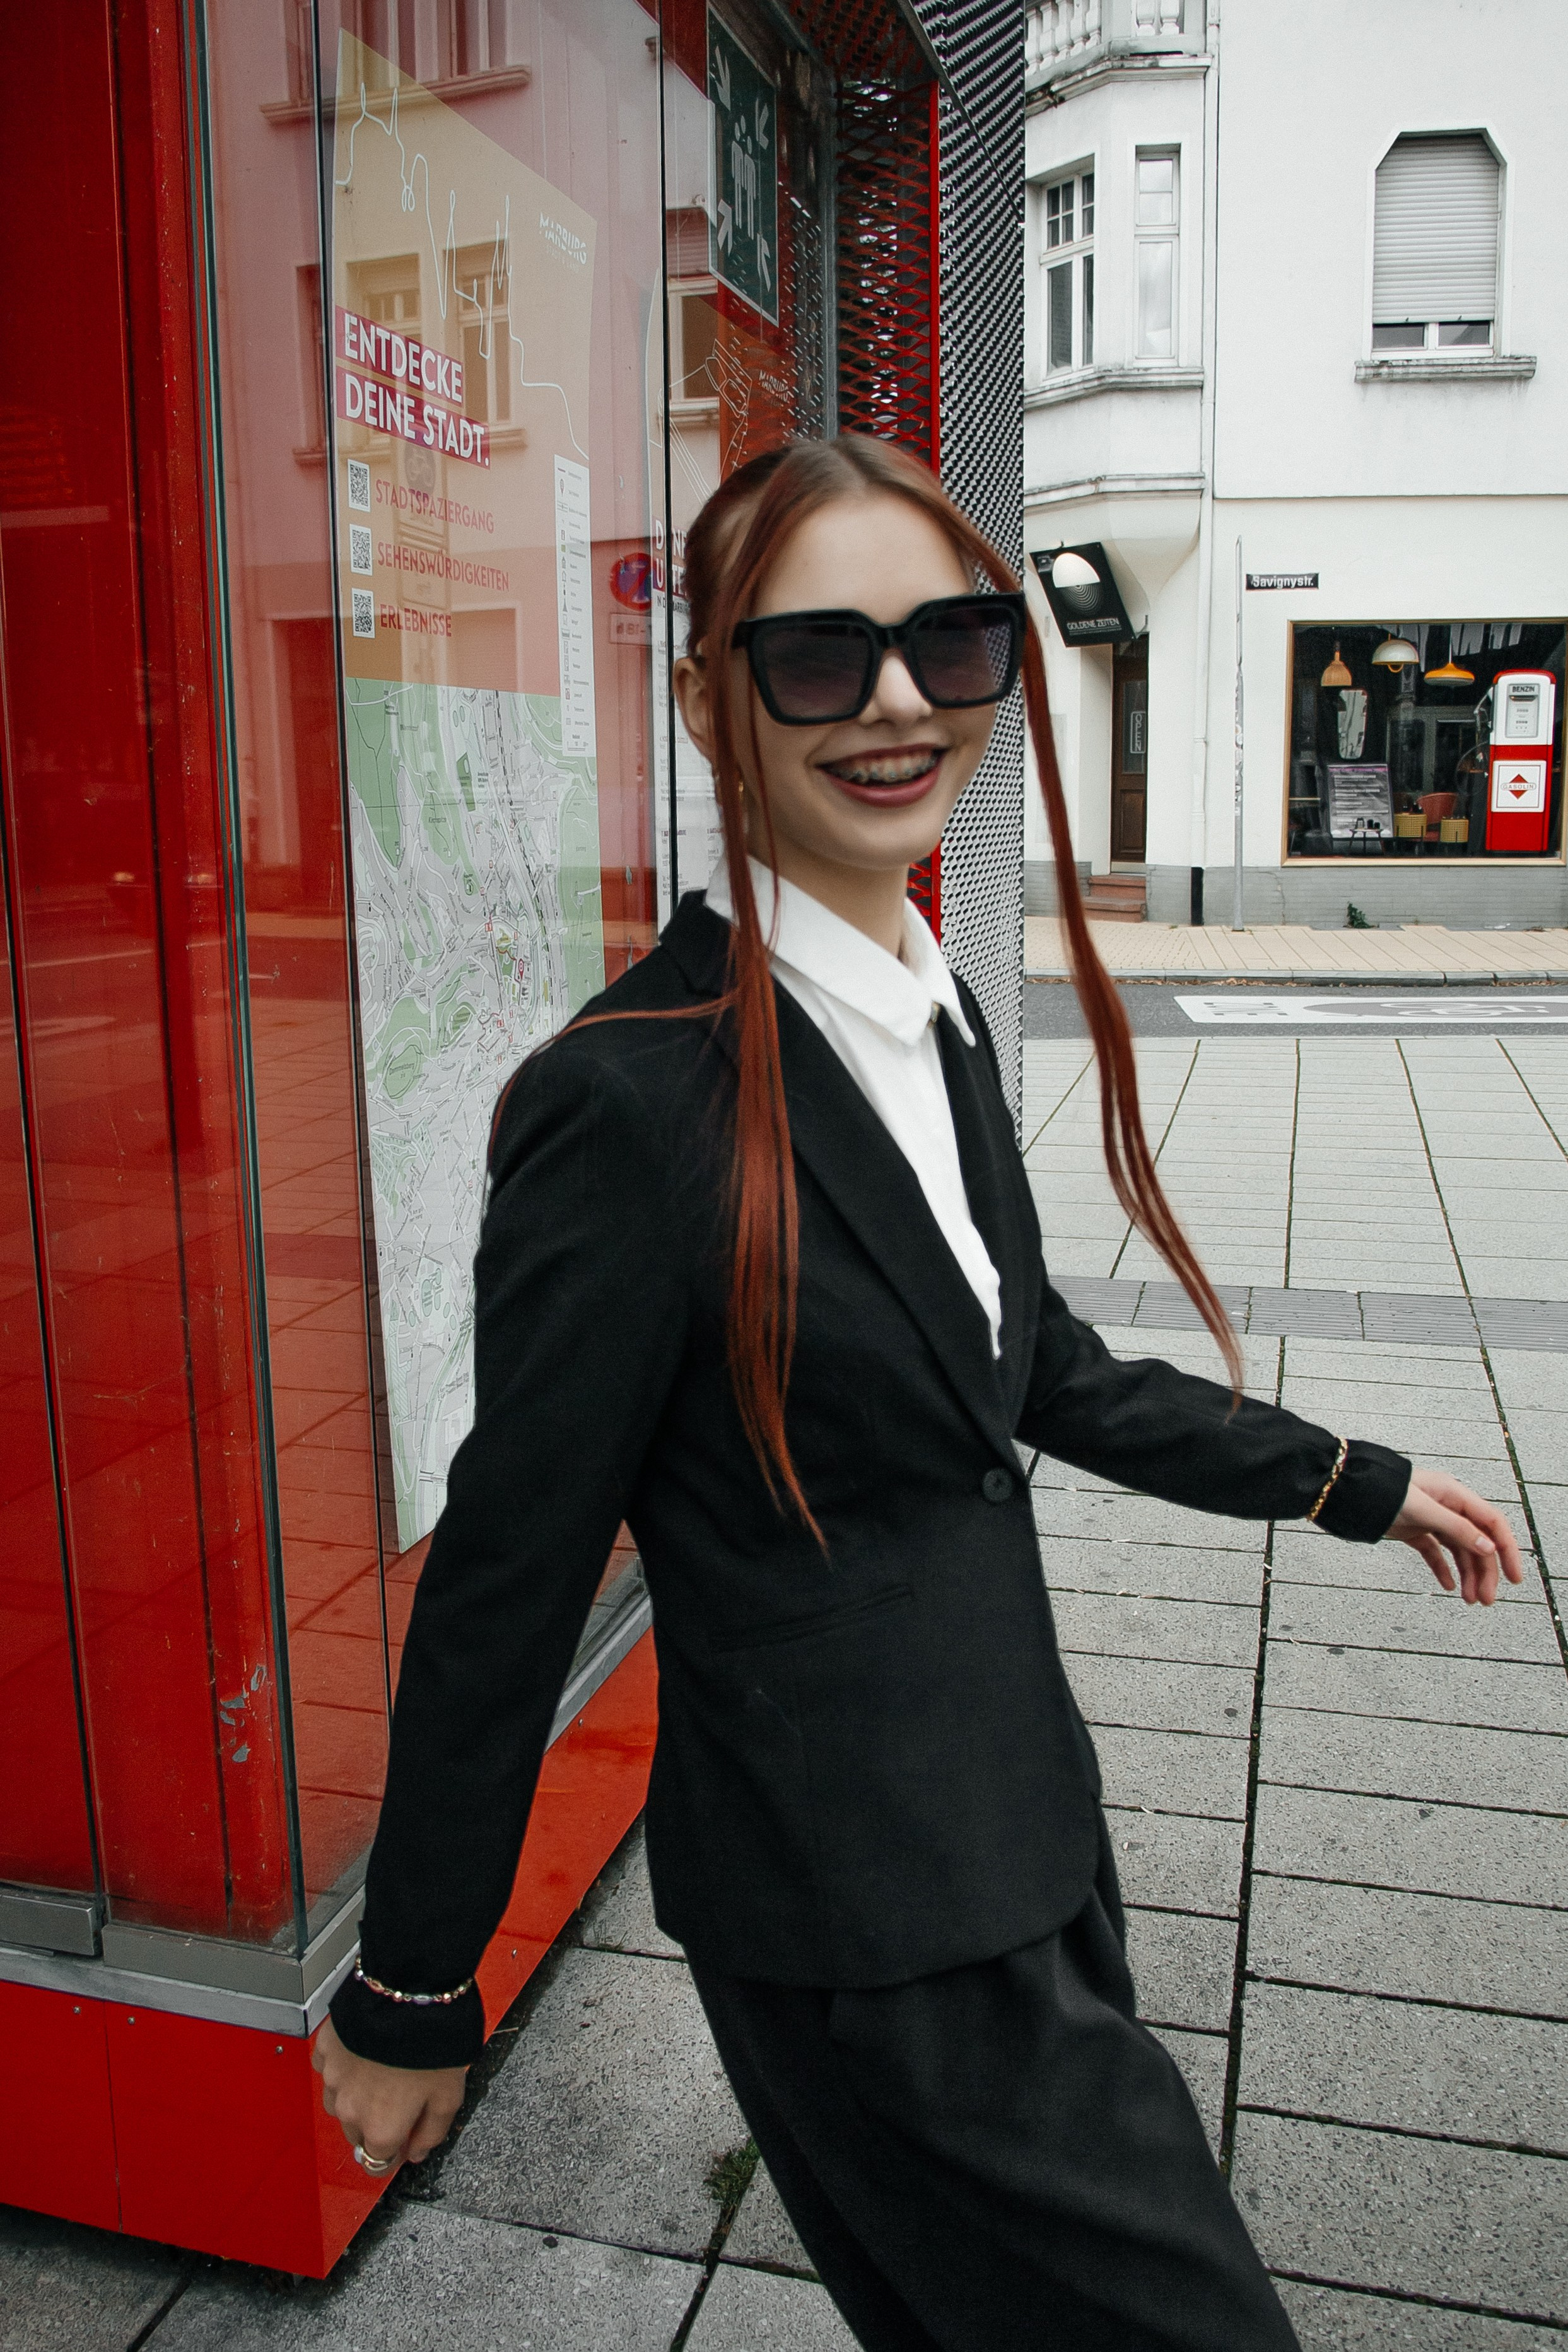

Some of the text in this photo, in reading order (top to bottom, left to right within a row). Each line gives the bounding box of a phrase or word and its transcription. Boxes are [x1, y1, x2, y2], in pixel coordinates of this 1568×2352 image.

[344, 313, 462, 403] ENTDECKE
[345, 373, 489, 466] DEINE STADT.
[376, 479, 494, 534] STADTSPAZIERGANG
[378, 541, 509, 592] SEHENSWÜRDIGKEITEN
[1251, 575, 1314, 589] Savignystr.
[380, 604, 452, 637] ERLEBNISSE
[1067, 617, 1120, 630] GOLDENE ZEITEN
